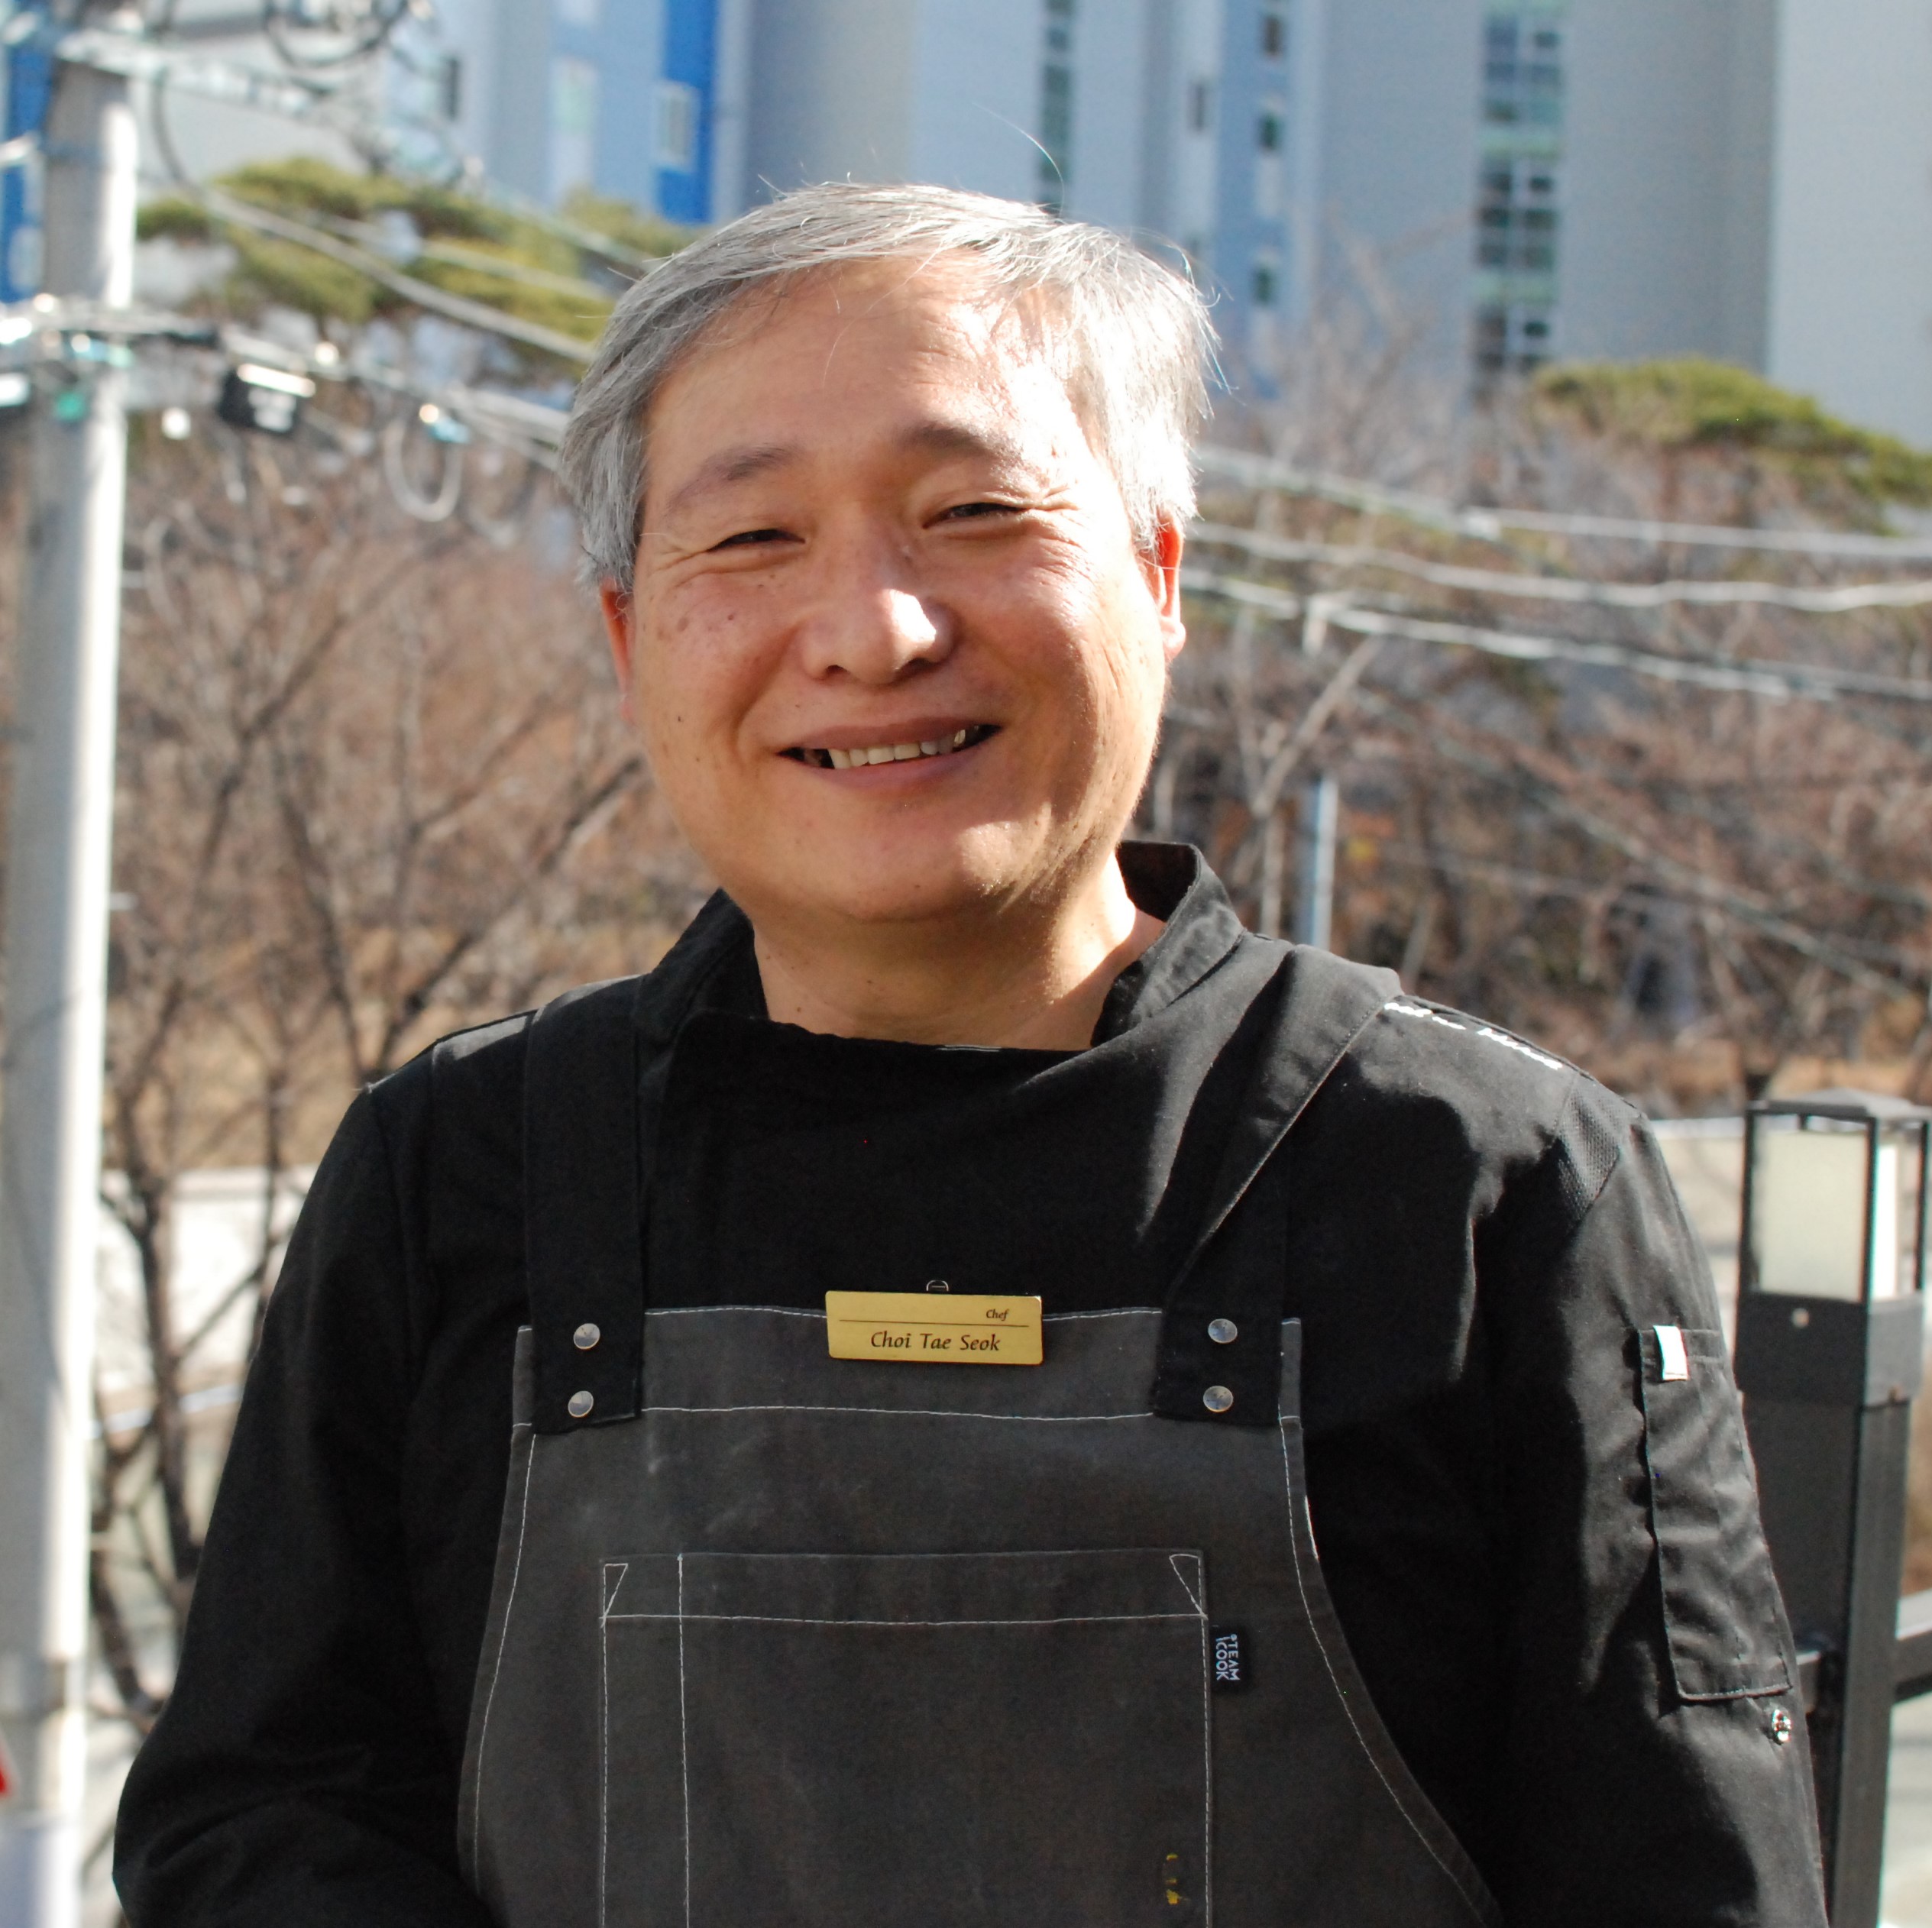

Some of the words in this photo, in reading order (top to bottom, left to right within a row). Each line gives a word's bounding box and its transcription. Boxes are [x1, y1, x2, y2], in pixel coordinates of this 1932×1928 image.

[986, 1309, 1009, 1322] Chef
[871, 1331, 911, 1349] Choi
[920, 1333, 952, 1350] Tae
[960, 1334, 1001, 1351] Seok
[1215, 1642, 1228, 1681] COOK
[1228, 1642, 1241, 1681] TEAM
